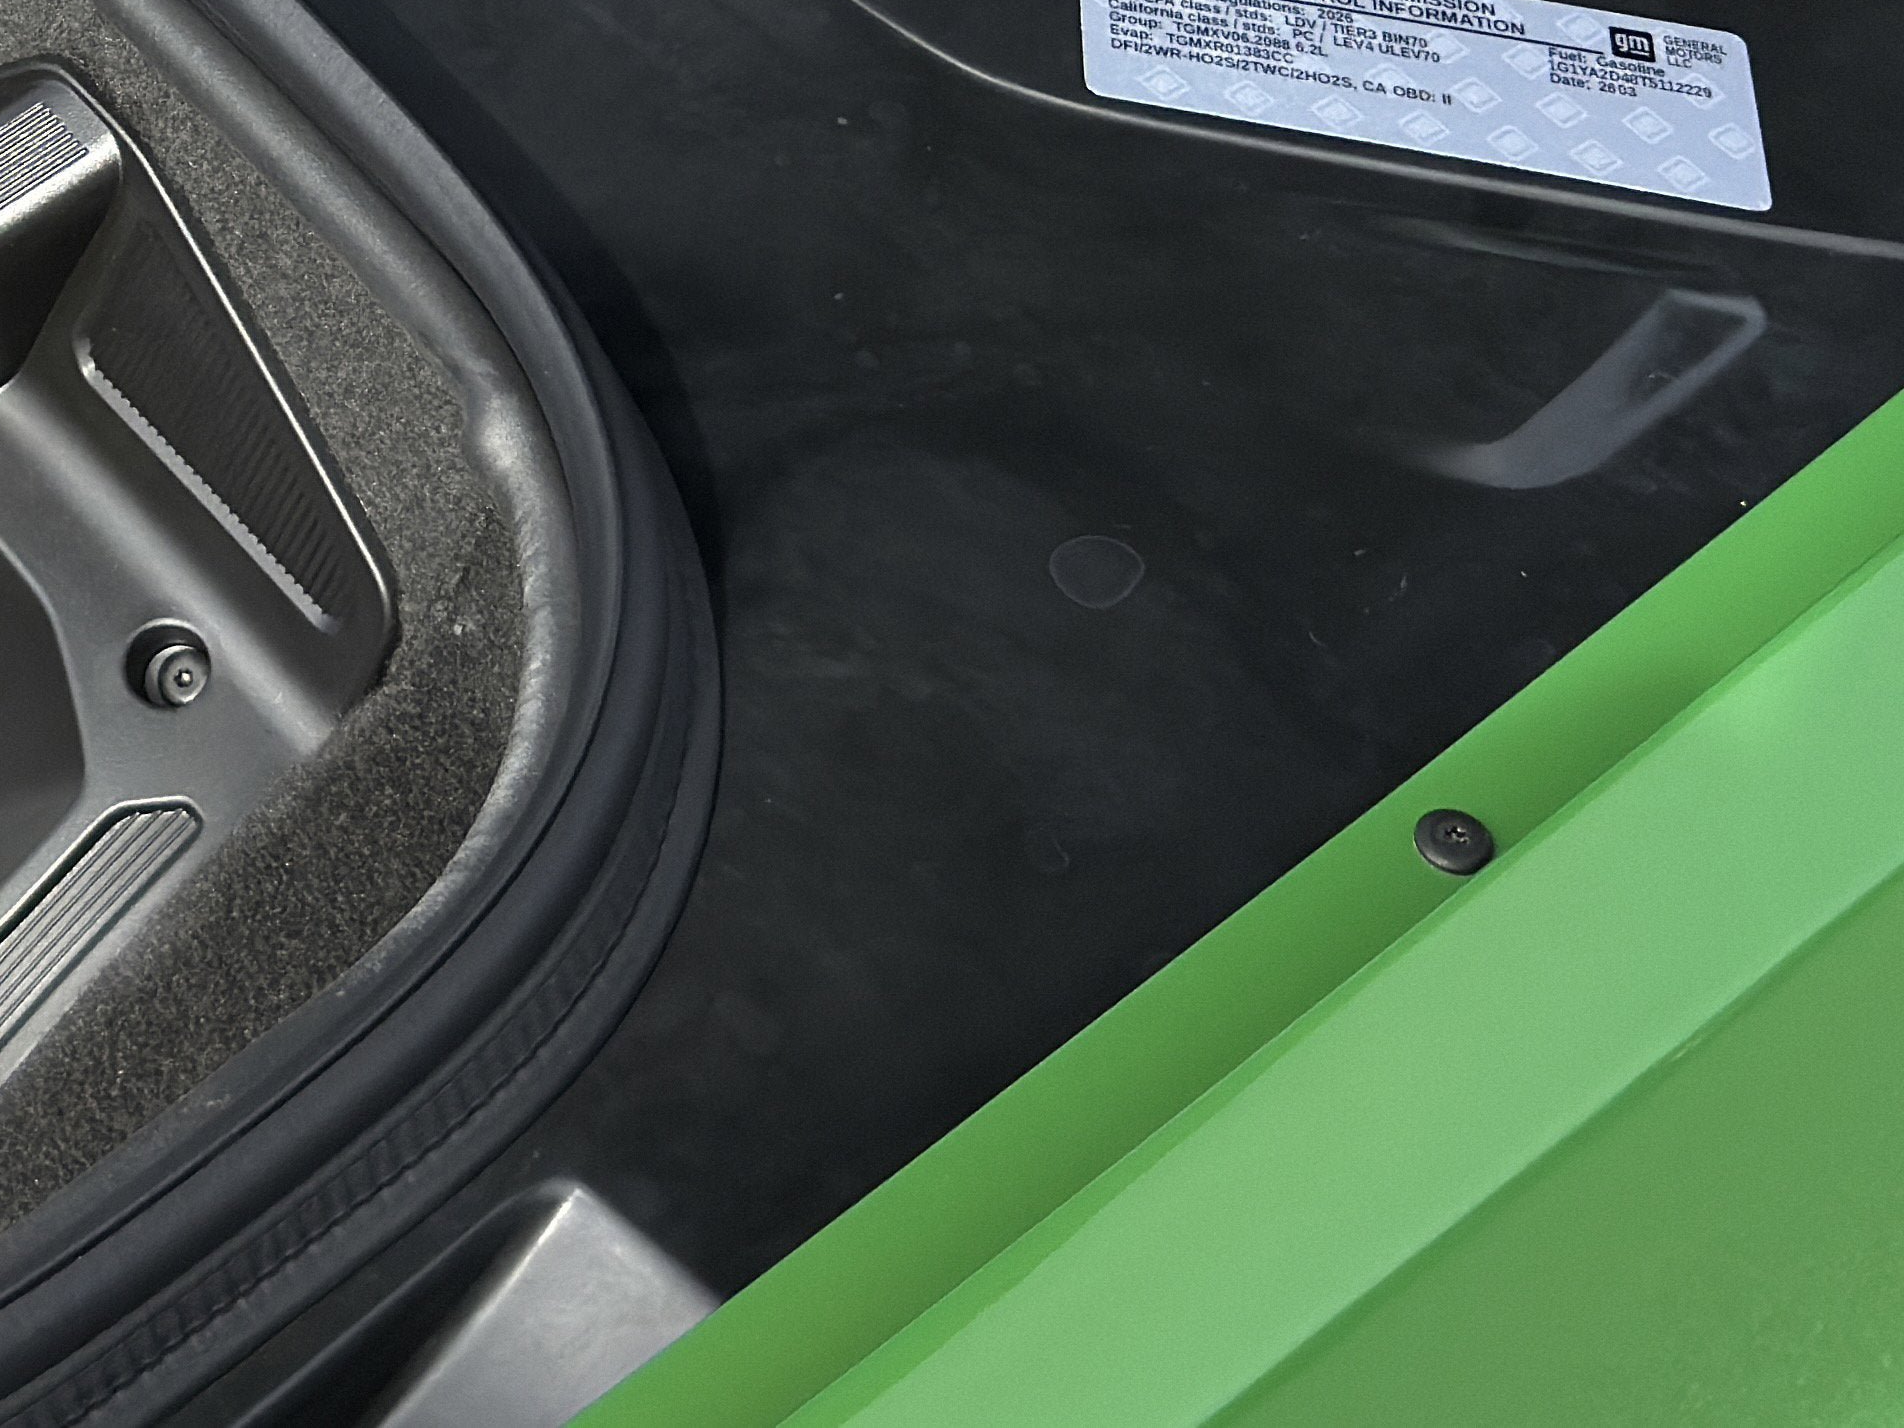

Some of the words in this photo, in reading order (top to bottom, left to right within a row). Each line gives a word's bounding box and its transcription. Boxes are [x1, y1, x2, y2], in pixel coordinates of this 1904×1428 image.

[1317, 8, 1353, 23] 2026
[1108, 10, 1162, 30] Group:
[1295, 41, 1328, 57] 6.2L
[1109, 23, 1153, 41] Evap:
[1188, 10, 1228, 27] class
[1242, 20, 1280, 36] stds:
[1292, 28, 1313, 42] PC
[1332, 35, 1374, 52] LEV4
[1378, 42, 1440, 63] ULEV70
[1235, 6, 1272, 22] stds:
[1284, 15, 1316, 29] LDV
[1330, 22, 1377, 40] TIER3
[1381, 31, 1427, 48] BIN70
[1614, 32, 1650, 56] gm
[1662, 34, 1727, 55] GENERAL
[1664, 45, 1722, 64] MOTORS
[1547, 46, 1586, 63] Fuel:
[1596, 55, 1665, 77] Gasoline
[1666, 55, 1692, 69] LLC
[1362, 80, 1386, 94] CA
[1392, 85, 1436, 103] OBD:
[1549, 72, 1590, 90] Date:
